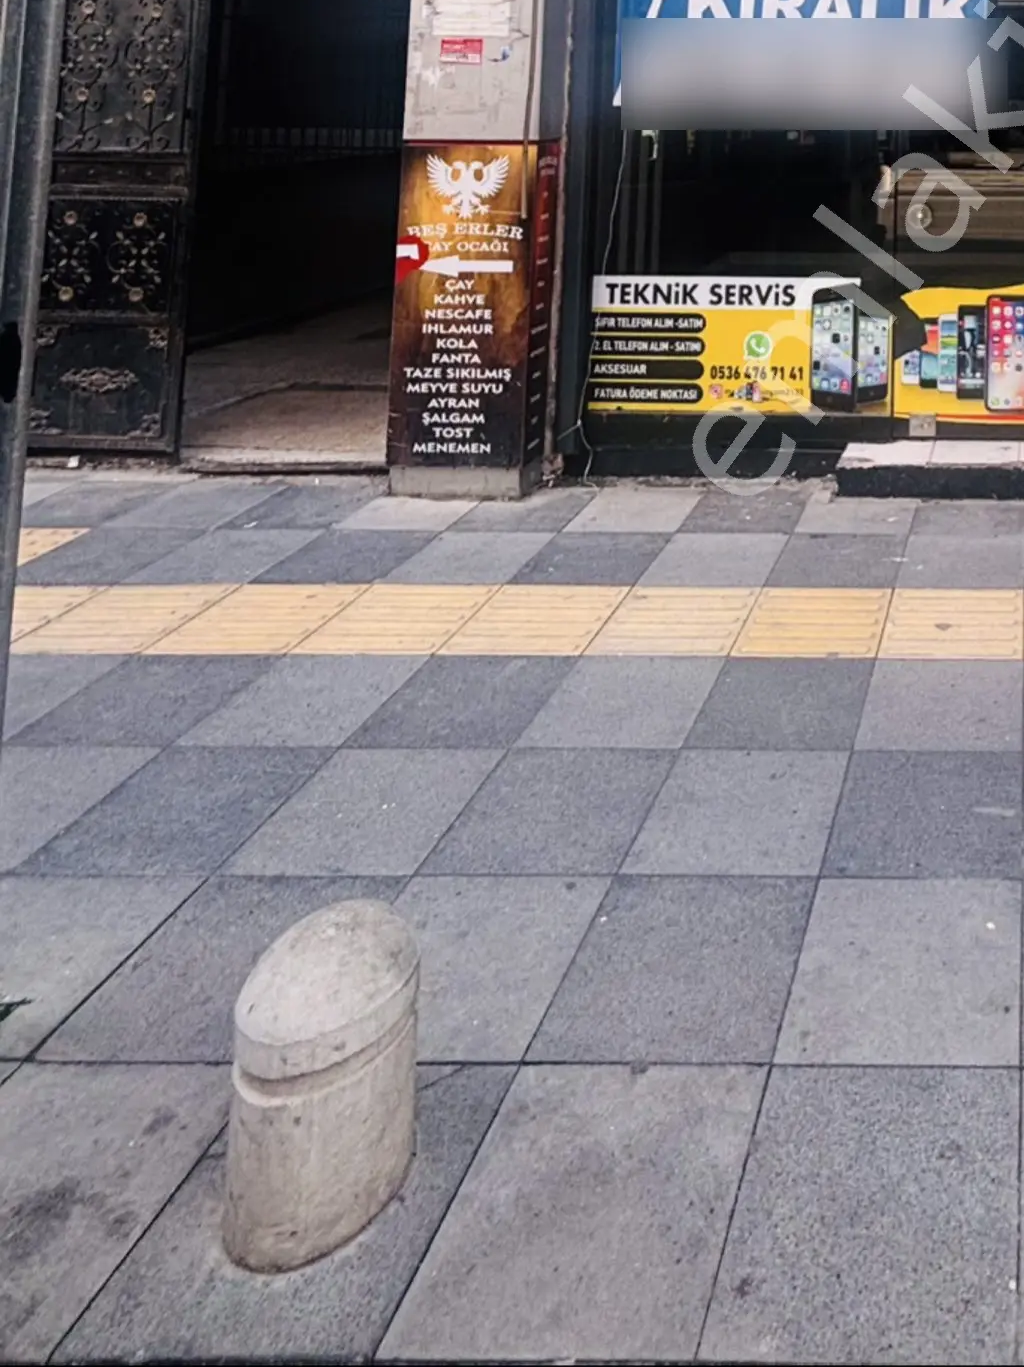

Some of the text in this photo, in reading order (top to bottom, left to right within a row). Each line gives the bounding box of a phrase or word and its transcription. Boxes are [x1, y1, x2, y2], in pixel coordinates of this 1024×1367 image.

[454, 222, 524, 240] ERLER
[457, 238, 510, 253] OCAĞI
[445, 279, 475, 292] ÇAY
[433, 294, 486, 305] KAHVE
[424, 309, 493, 320] NESCAFE
[617, 317, 653, 328] TELEFON
[421, 324, 493, 335] IHLAMUR
[436, 338, 478, 349] KOLA
[614, 341, 648, 351] TELEFON
[431, 353, 481, 364] FANTA
[403, 367, 512, 382] TAZE SIKILMIŞ
[594, 364, 647, 374] AKSESUAR
[710, 365, 804, 380] 0536 476 71 41
[406, 382, 503, 394] MEYVE SUYU
[594, 387, 628, 398] FATURA
[427, 397, 480, 408] AYRAN
[432, 427, 474, 438] TOST
[412, 443, 491, 454] MENEMEN
